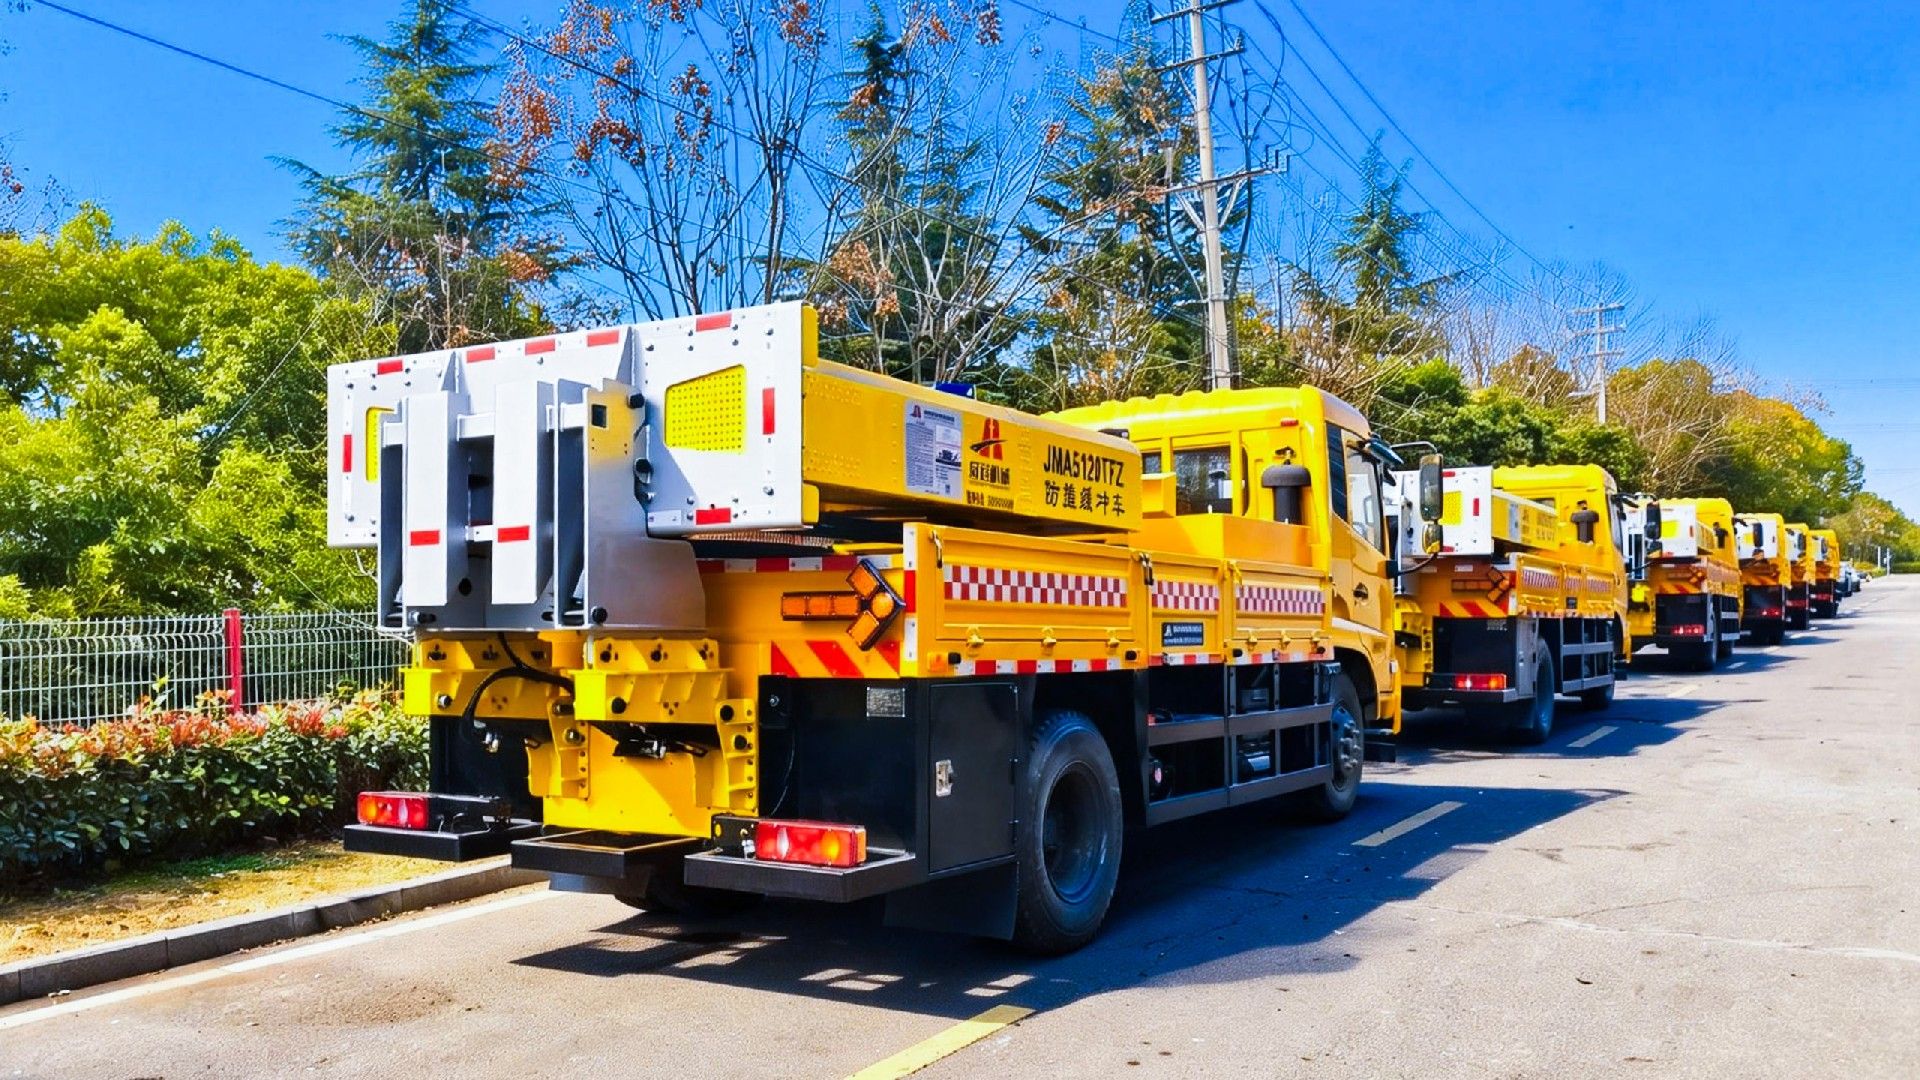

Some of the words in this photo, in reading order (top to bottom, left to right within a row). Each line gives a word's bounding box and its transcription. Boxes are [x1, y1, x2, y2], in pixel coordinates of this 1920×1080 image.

[1043, 444, 1125, 488] JMA5120TFZ
[1044, 479, 1126, 517] 防撞缓冲车
